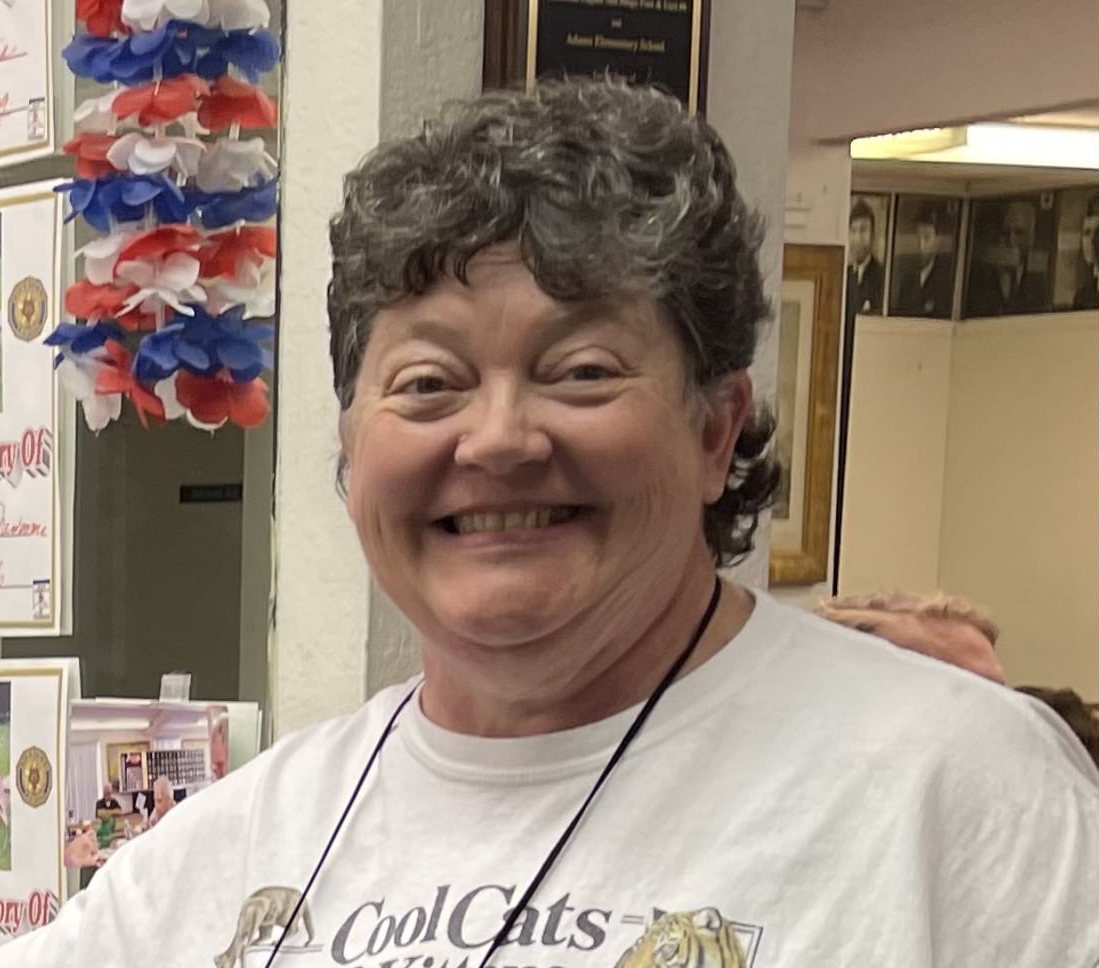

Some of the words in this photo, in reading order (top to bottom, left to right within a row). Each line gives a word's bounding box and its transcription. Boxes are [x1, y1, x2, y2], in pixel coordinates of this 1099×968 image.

[22, 428, 44, 466] Of
[29, 891, 50, 926] Of
[330, 884, 450, 966] Cool
[446, 884, 612, 951] Cats
